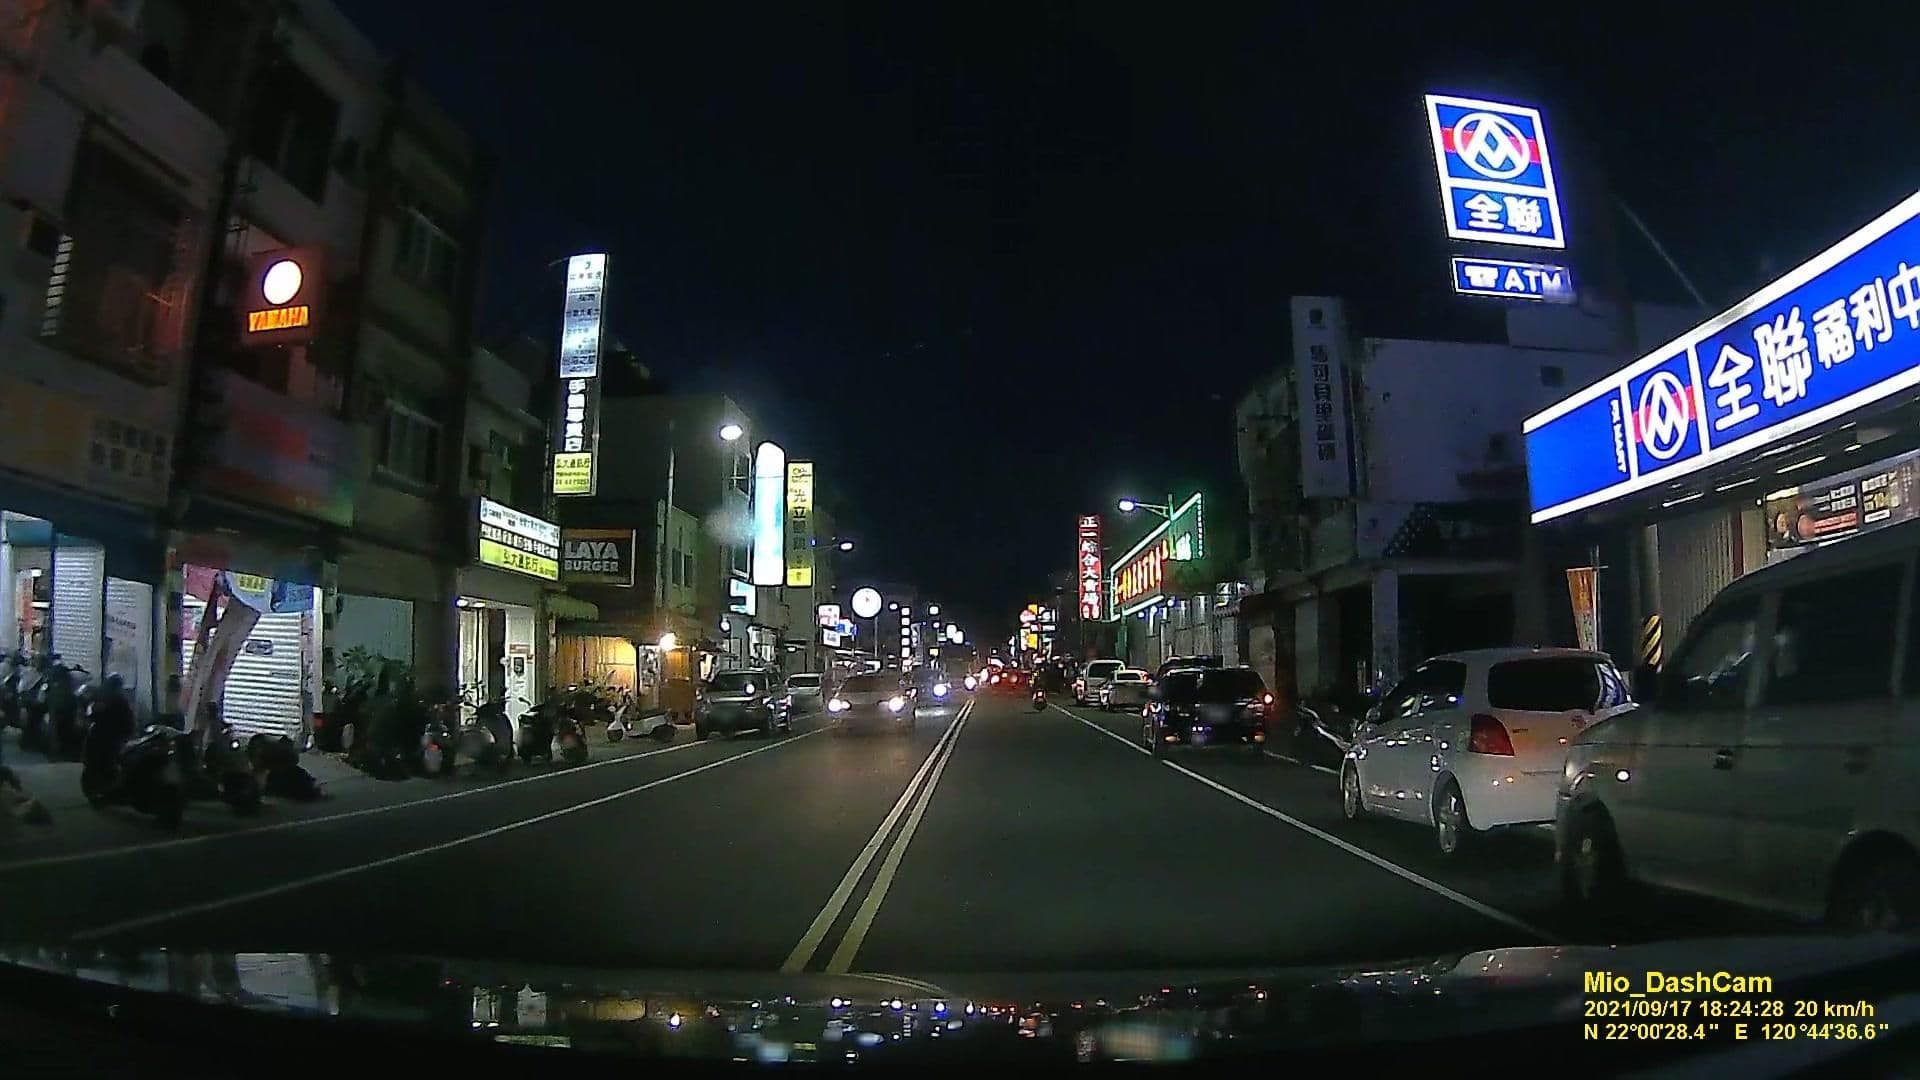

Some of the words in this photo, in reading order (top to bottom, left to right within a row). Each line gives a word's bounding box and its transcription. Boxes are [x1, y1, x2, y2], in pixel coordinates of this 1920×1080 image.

[1464, 193, 1542, 233] 全聯
[1504, 268, 1562, 293] ATM
[248, 306, 309, 332] YAMAHA
[1708, 261, 1920, 432] 全聯福利中
[564, 541, 619, 559] LAYA
[564, 560, 619, 573] BURGER
